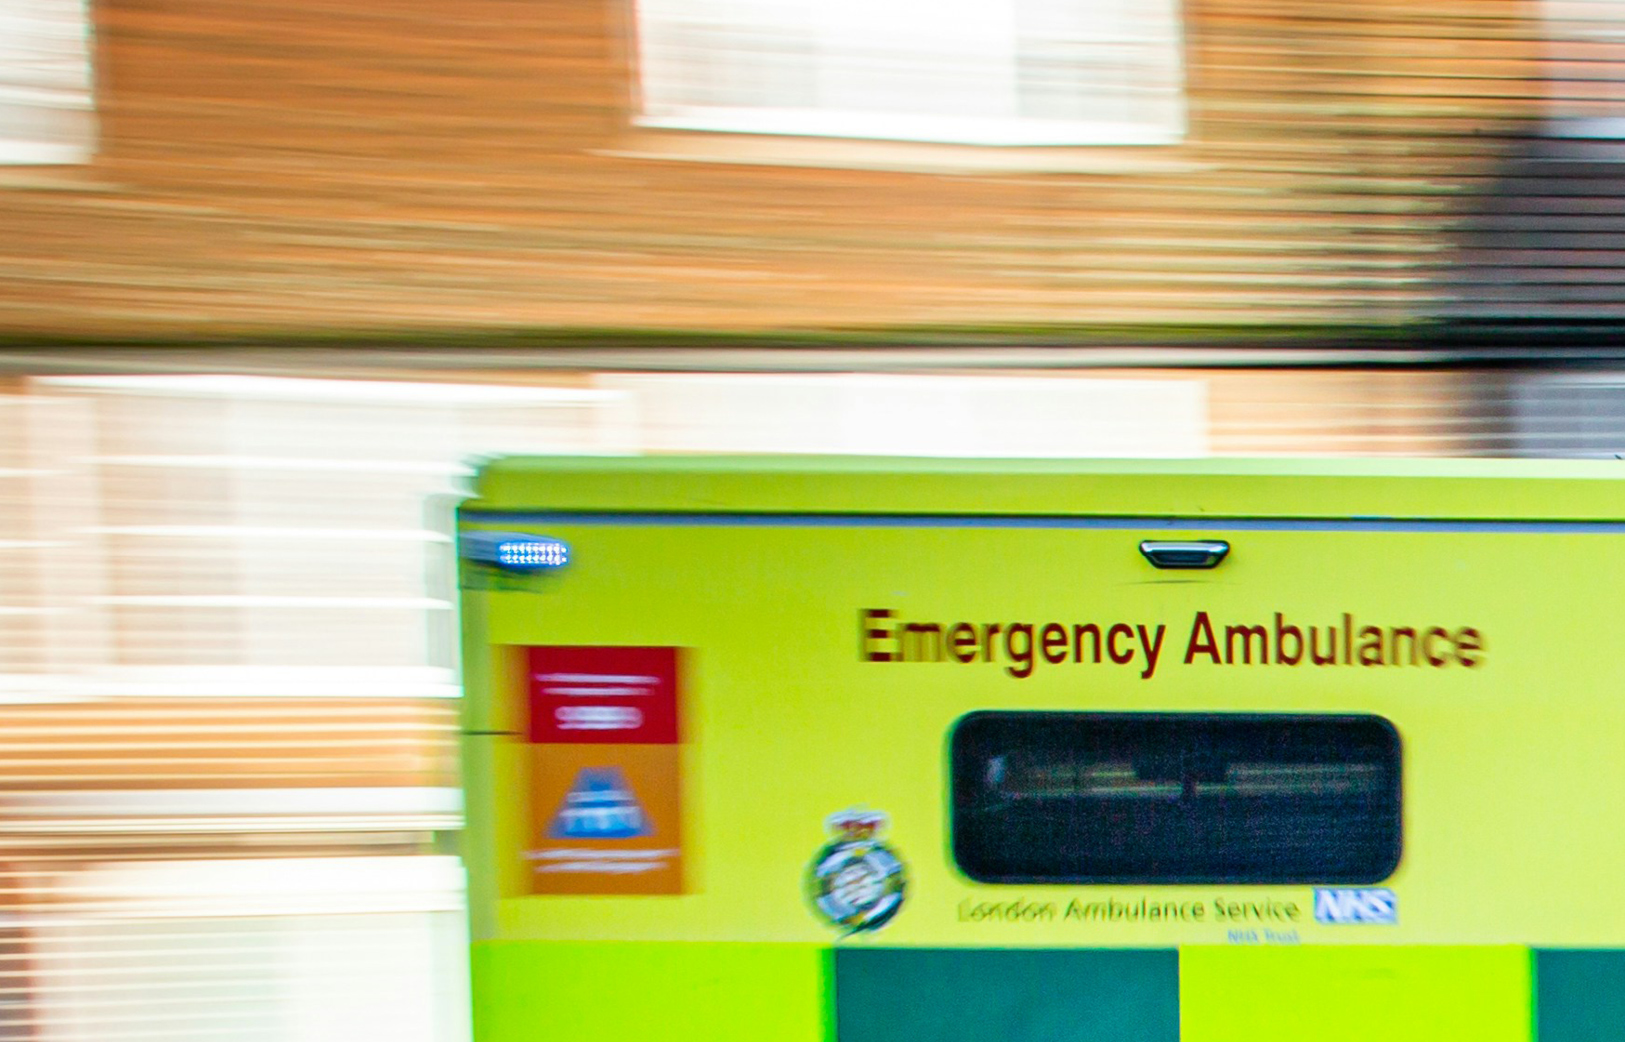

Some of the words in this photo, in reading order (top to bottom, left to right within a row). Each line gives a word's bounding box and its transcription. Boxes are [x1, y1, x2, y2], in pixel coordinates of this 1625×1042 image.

[859, 608, 1166, 680] Emergency
[1184, 611, 1487, 667] Ambulance
[957, 896, 1054, 923] London
[1064, 896, 1206, 923] Ambulance
[1214, 896, 1301, 923] Service
[1316, 888, 1395, 922] NHS
